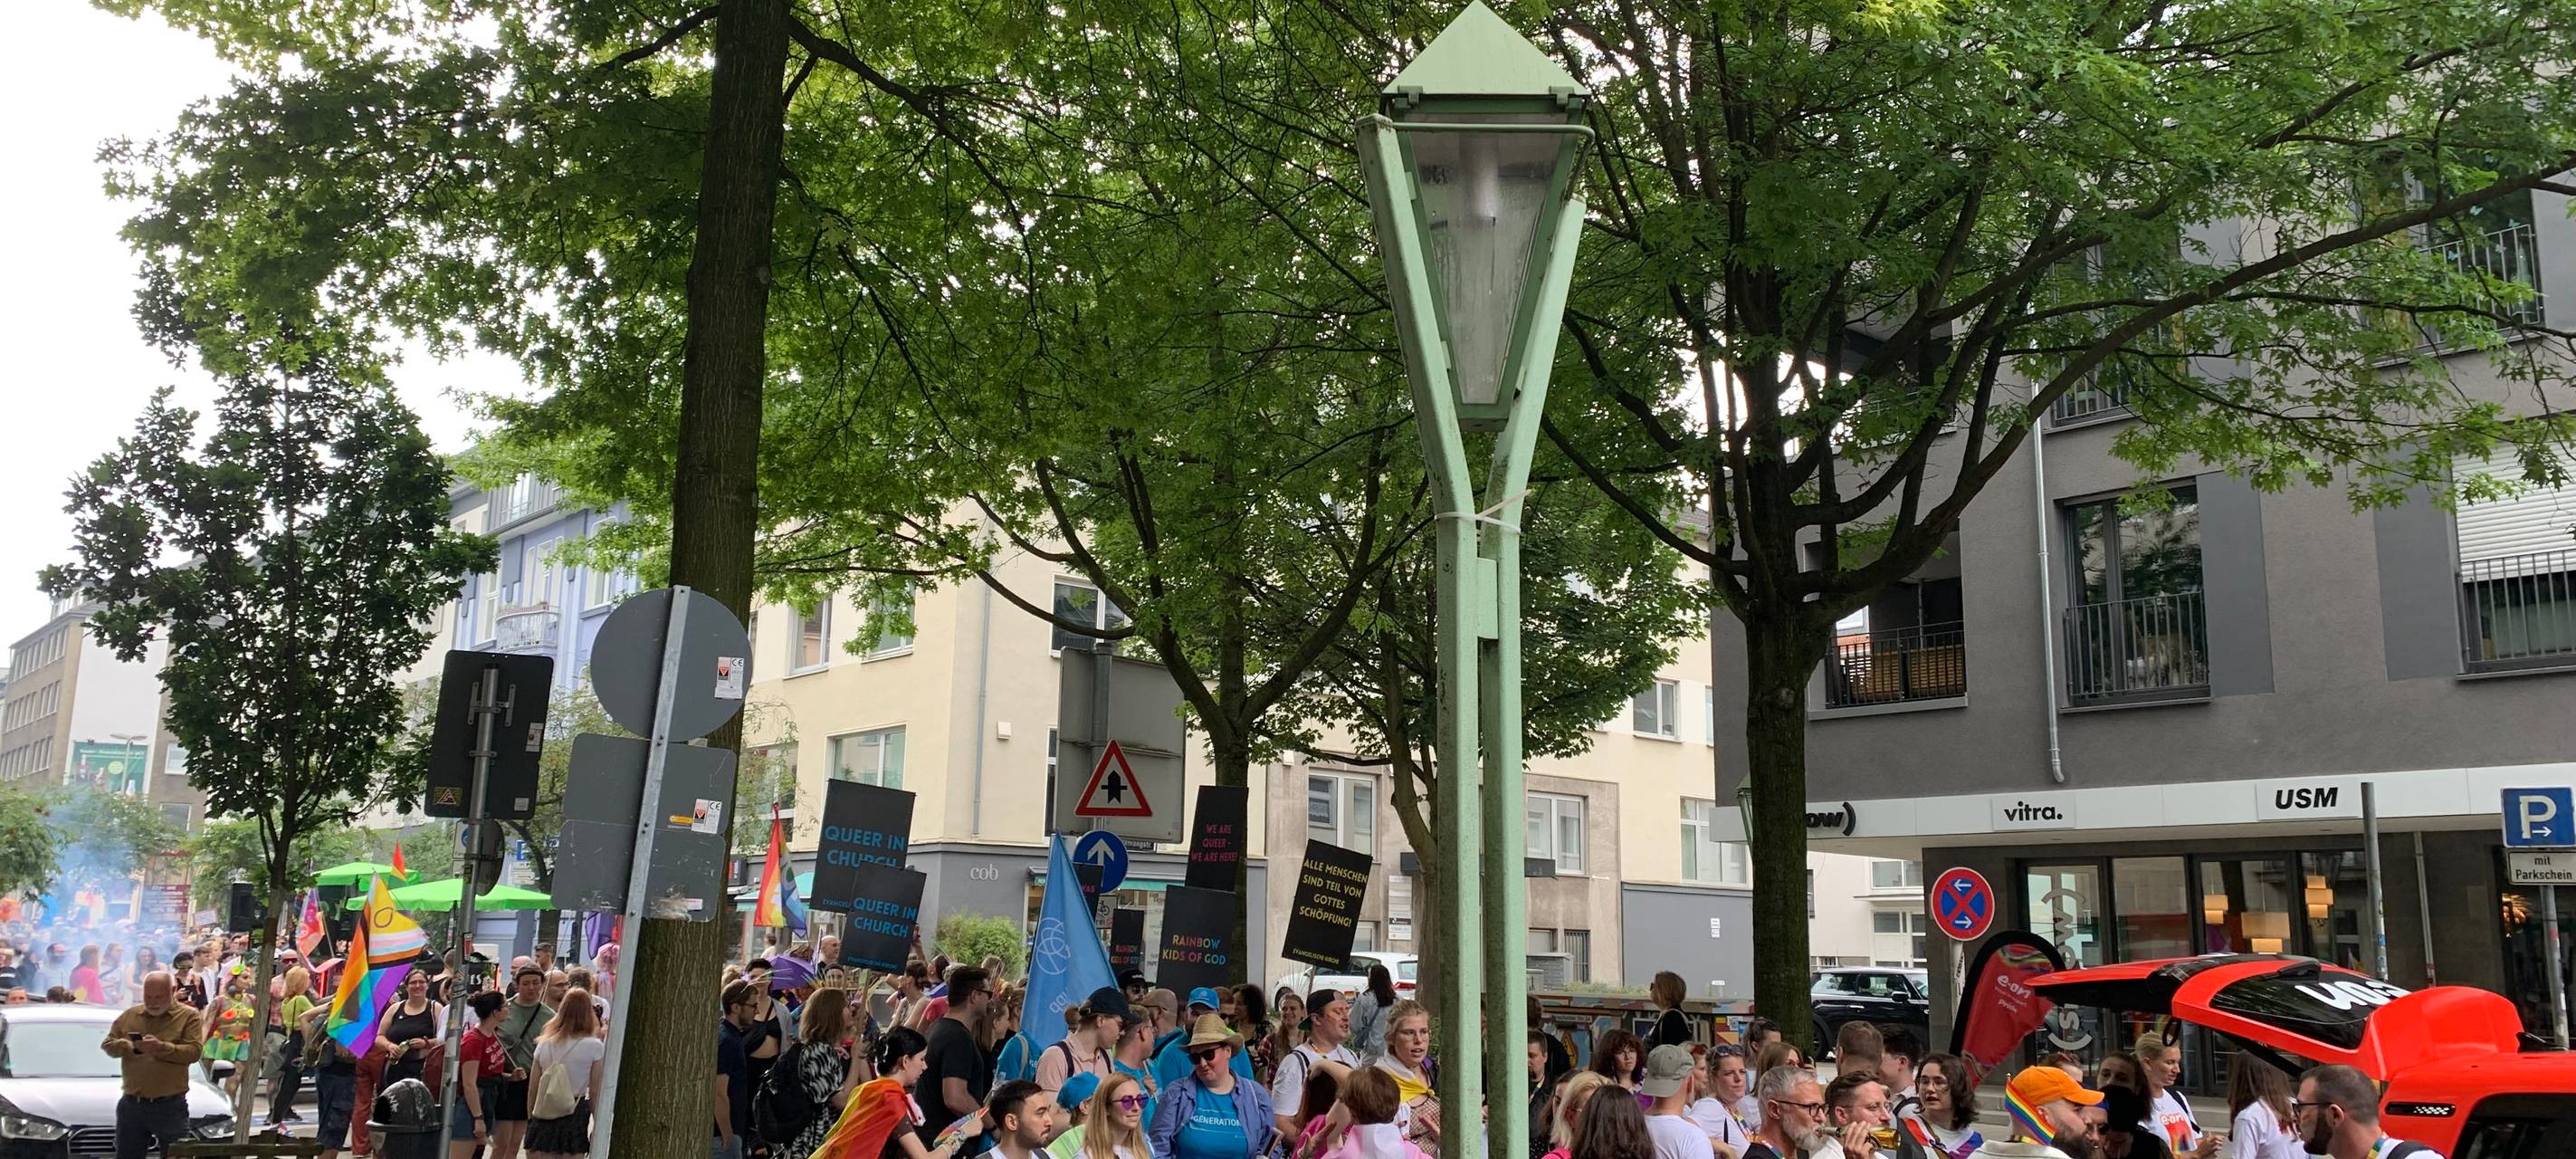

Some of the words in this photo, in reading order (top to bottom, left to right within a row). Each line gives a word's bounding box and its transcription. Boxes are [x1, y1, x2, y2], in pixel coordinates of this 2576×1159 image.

[2275, 787, 2338, 809] USM
[2003, 800, 2063, 822] vitra.
[2519, 795, 2557, 838] P
[825, 825, 883, 848] QUEER
[887, 833, 905, 852] IN
[1206, 824, 1216, 834] WE
[1218, 824, 1232, 834] ARE
[969, 863, 999, 880] cob
[1303, 857, 1324, 872] ALLE
[1324, 865, 1369, 884] MENSCHEN
[2534, 856, 2552, 866] mit
[2515, 868, 2572, 880] Parkschein
[1302, 874, 1324, 887] SIND
[1325, 880, 1341, 893] TEIL
[1343, 885, 1362, 898] VON
[854, 897, 899, 917] QUEER
[903, 905, 918, 921] IN
[1313, 893, 1346, 910] GOTTES
[854, 916, 909, 938] CHURCH
[1299, 905, 1352, 928] SCHÖPFUNG!
[1172, 934, 1221, 950] RAINBOW
[1162, 949, 1186, 962] KIDS
[1188, 952, 1202, 964] OF
[1204, 953, 1226, 966] GOD
